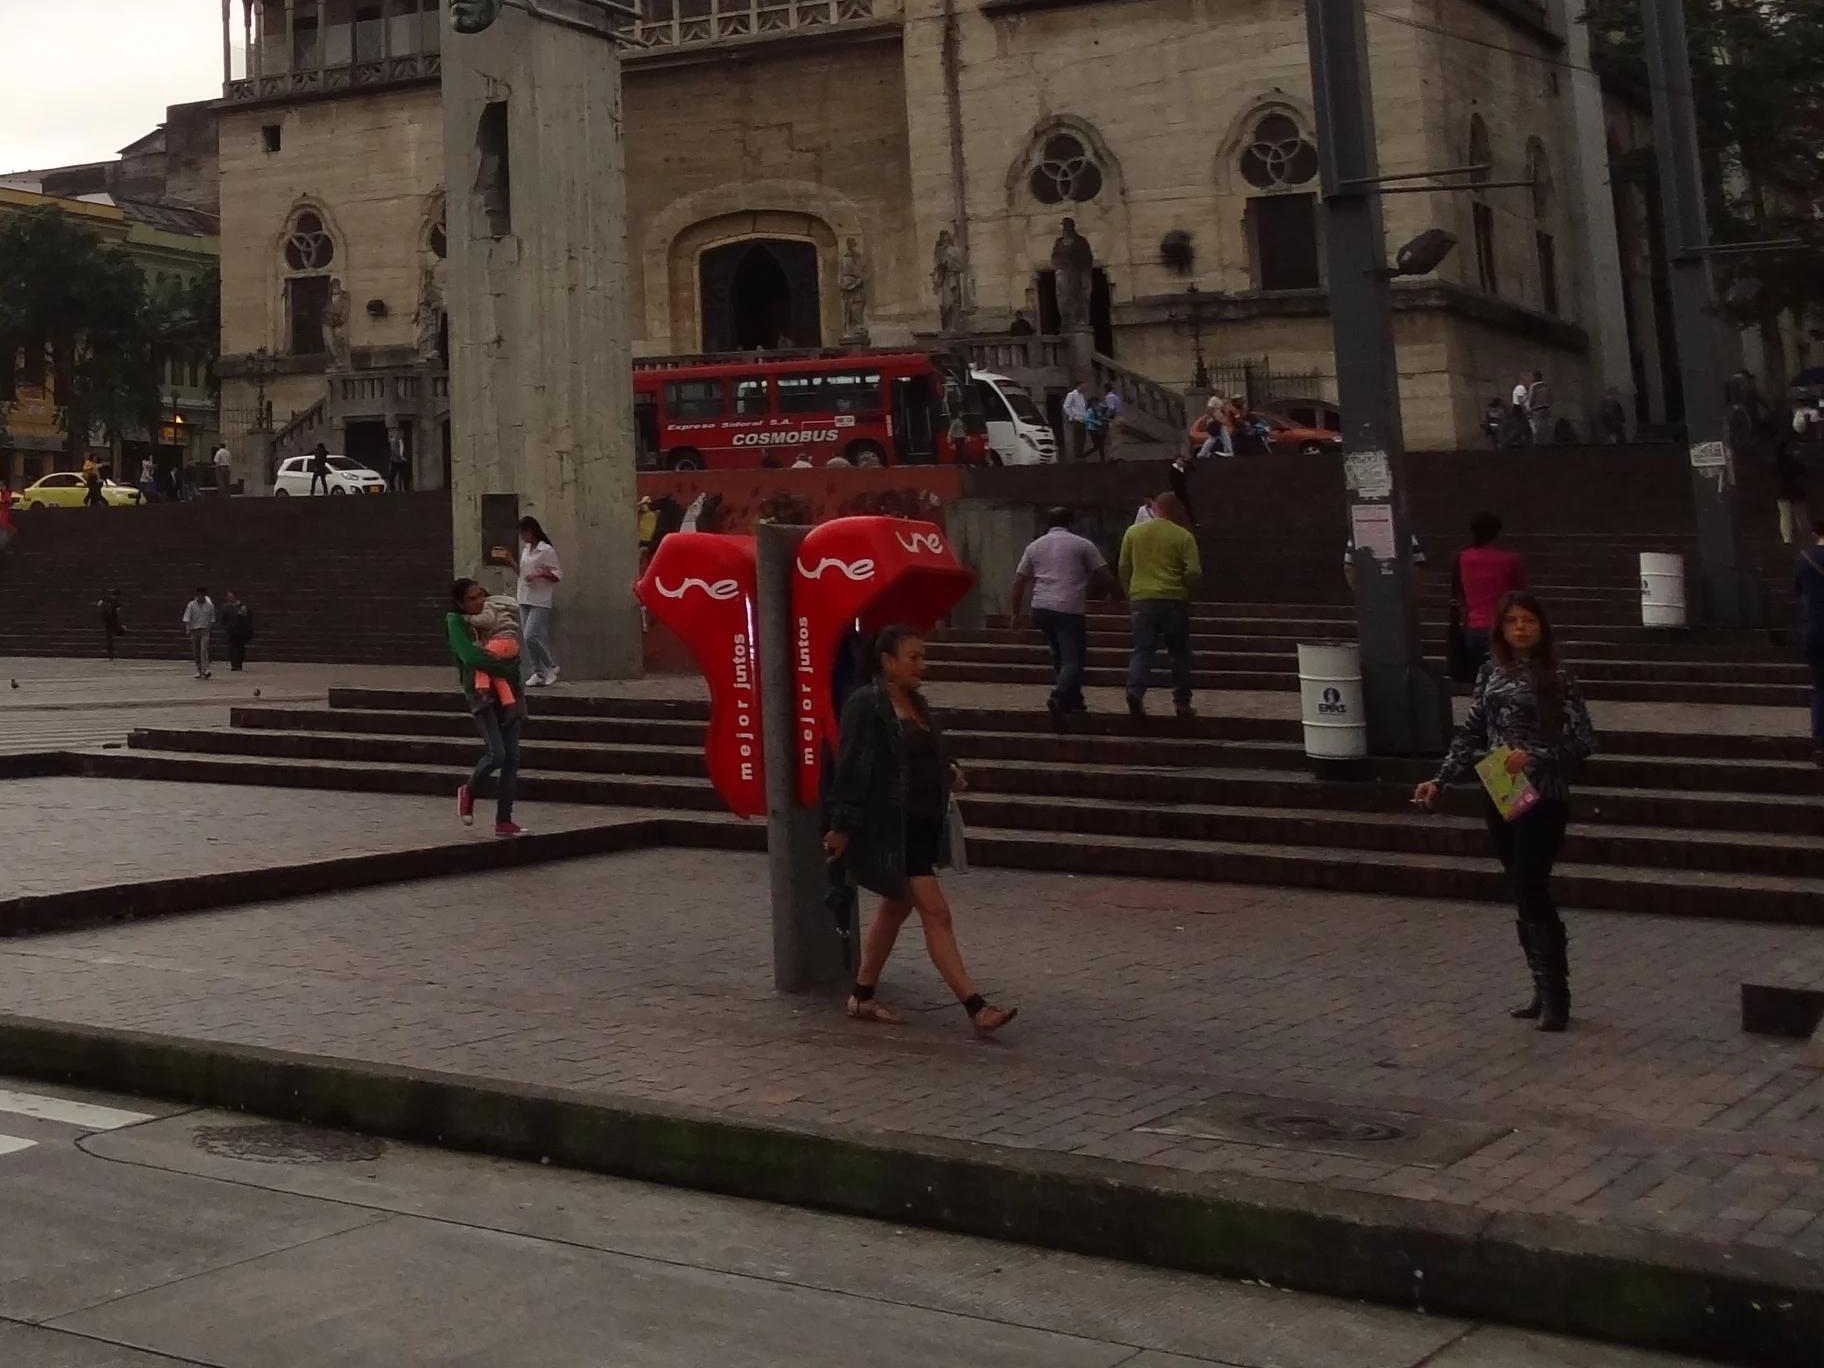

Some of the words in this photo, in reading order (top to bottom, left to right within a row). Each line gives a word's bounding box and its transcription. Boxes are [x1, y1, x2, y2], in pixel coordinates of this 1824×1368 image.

[769, 418, 793, 426] S.A.
[732, 429, 839, 445] COSMOBUS
[895, 531, 943, 555] une
[796, 557, 875, 581] une
[654, 576, 740, 600] une
[797, 616, 813, 674] juntos
[733, 633, 752, 690] juntos
[799, 683, 814, 767] mejor
[735, 699, 754, 781] mejor
